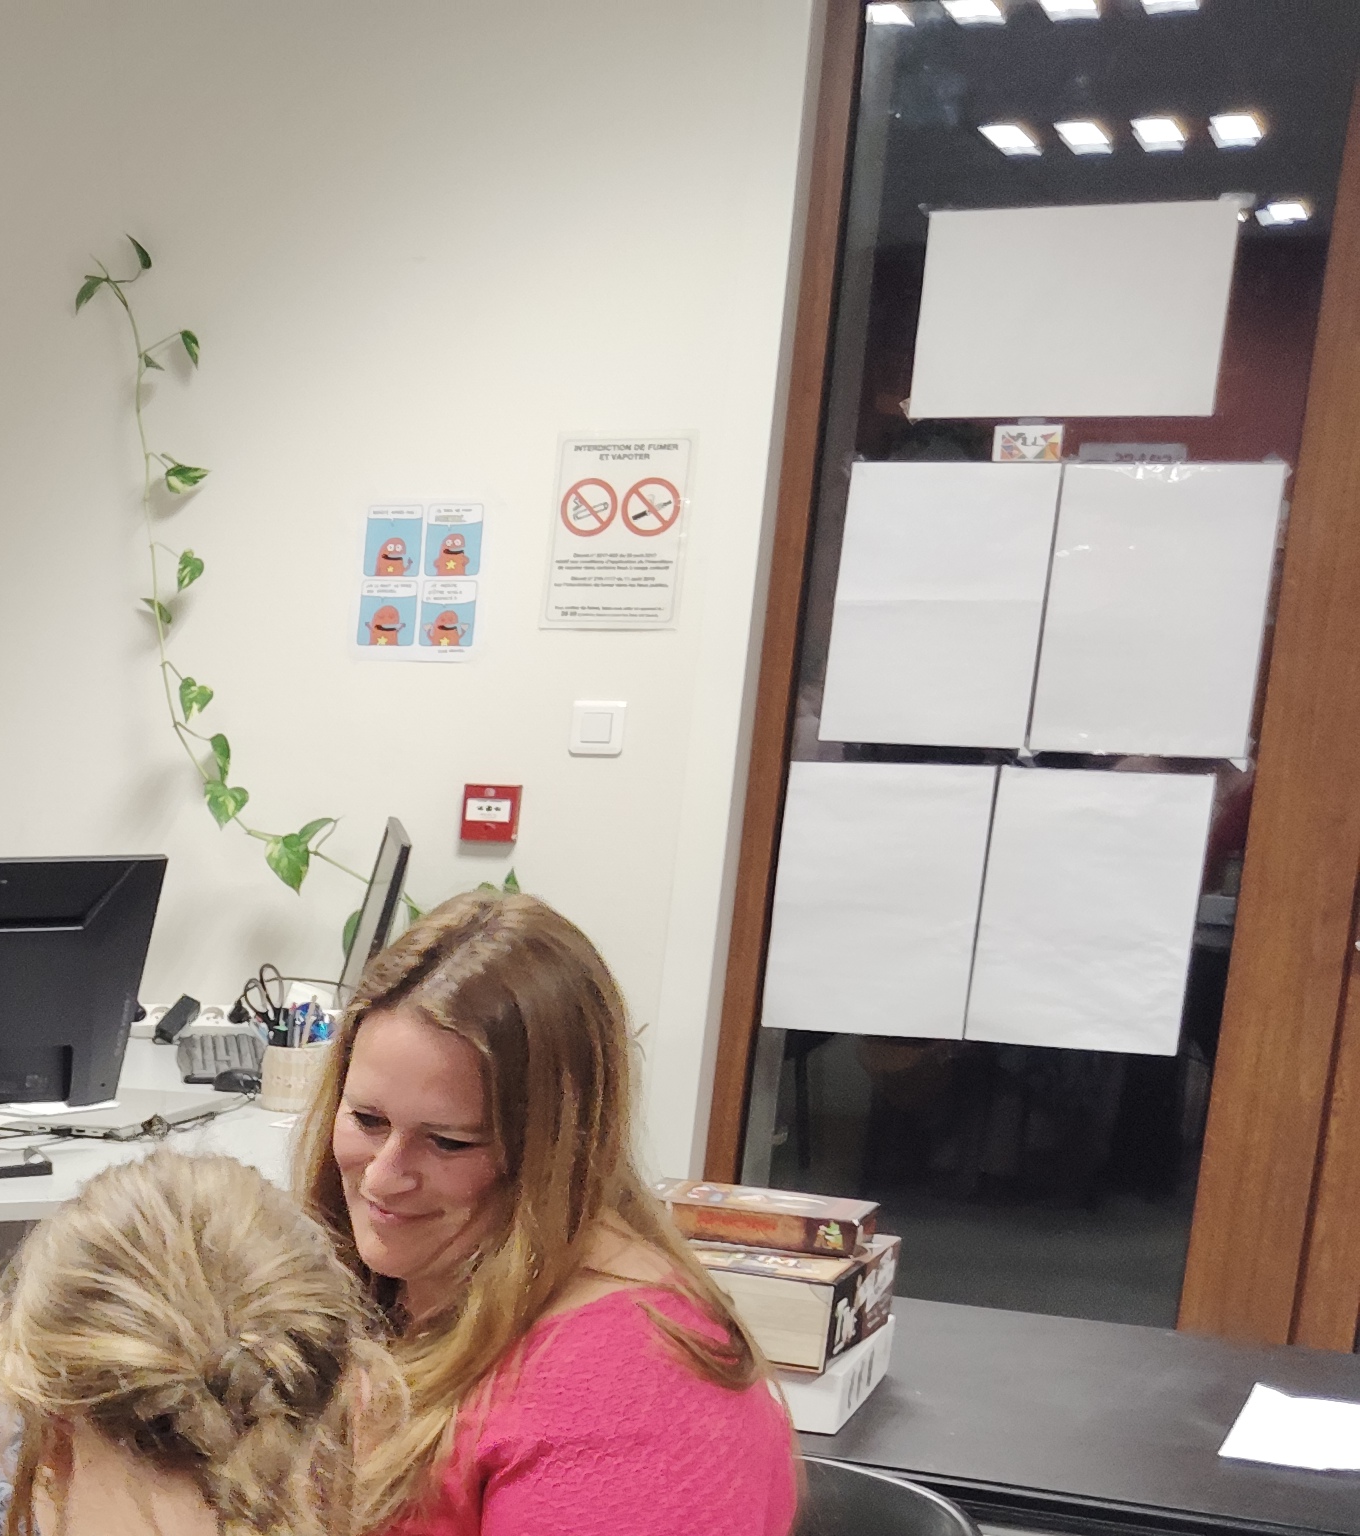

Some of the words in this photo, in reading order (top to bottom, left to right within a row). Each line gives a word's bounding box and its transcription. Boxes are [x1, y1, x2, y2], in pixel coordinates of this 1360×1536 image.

[573, 444, 631, 452] INTERDICTION
[634, 443, 645, 451] DE
[647, 443, 679, 451] FUMER
[599, 453, 609, 461] ET
